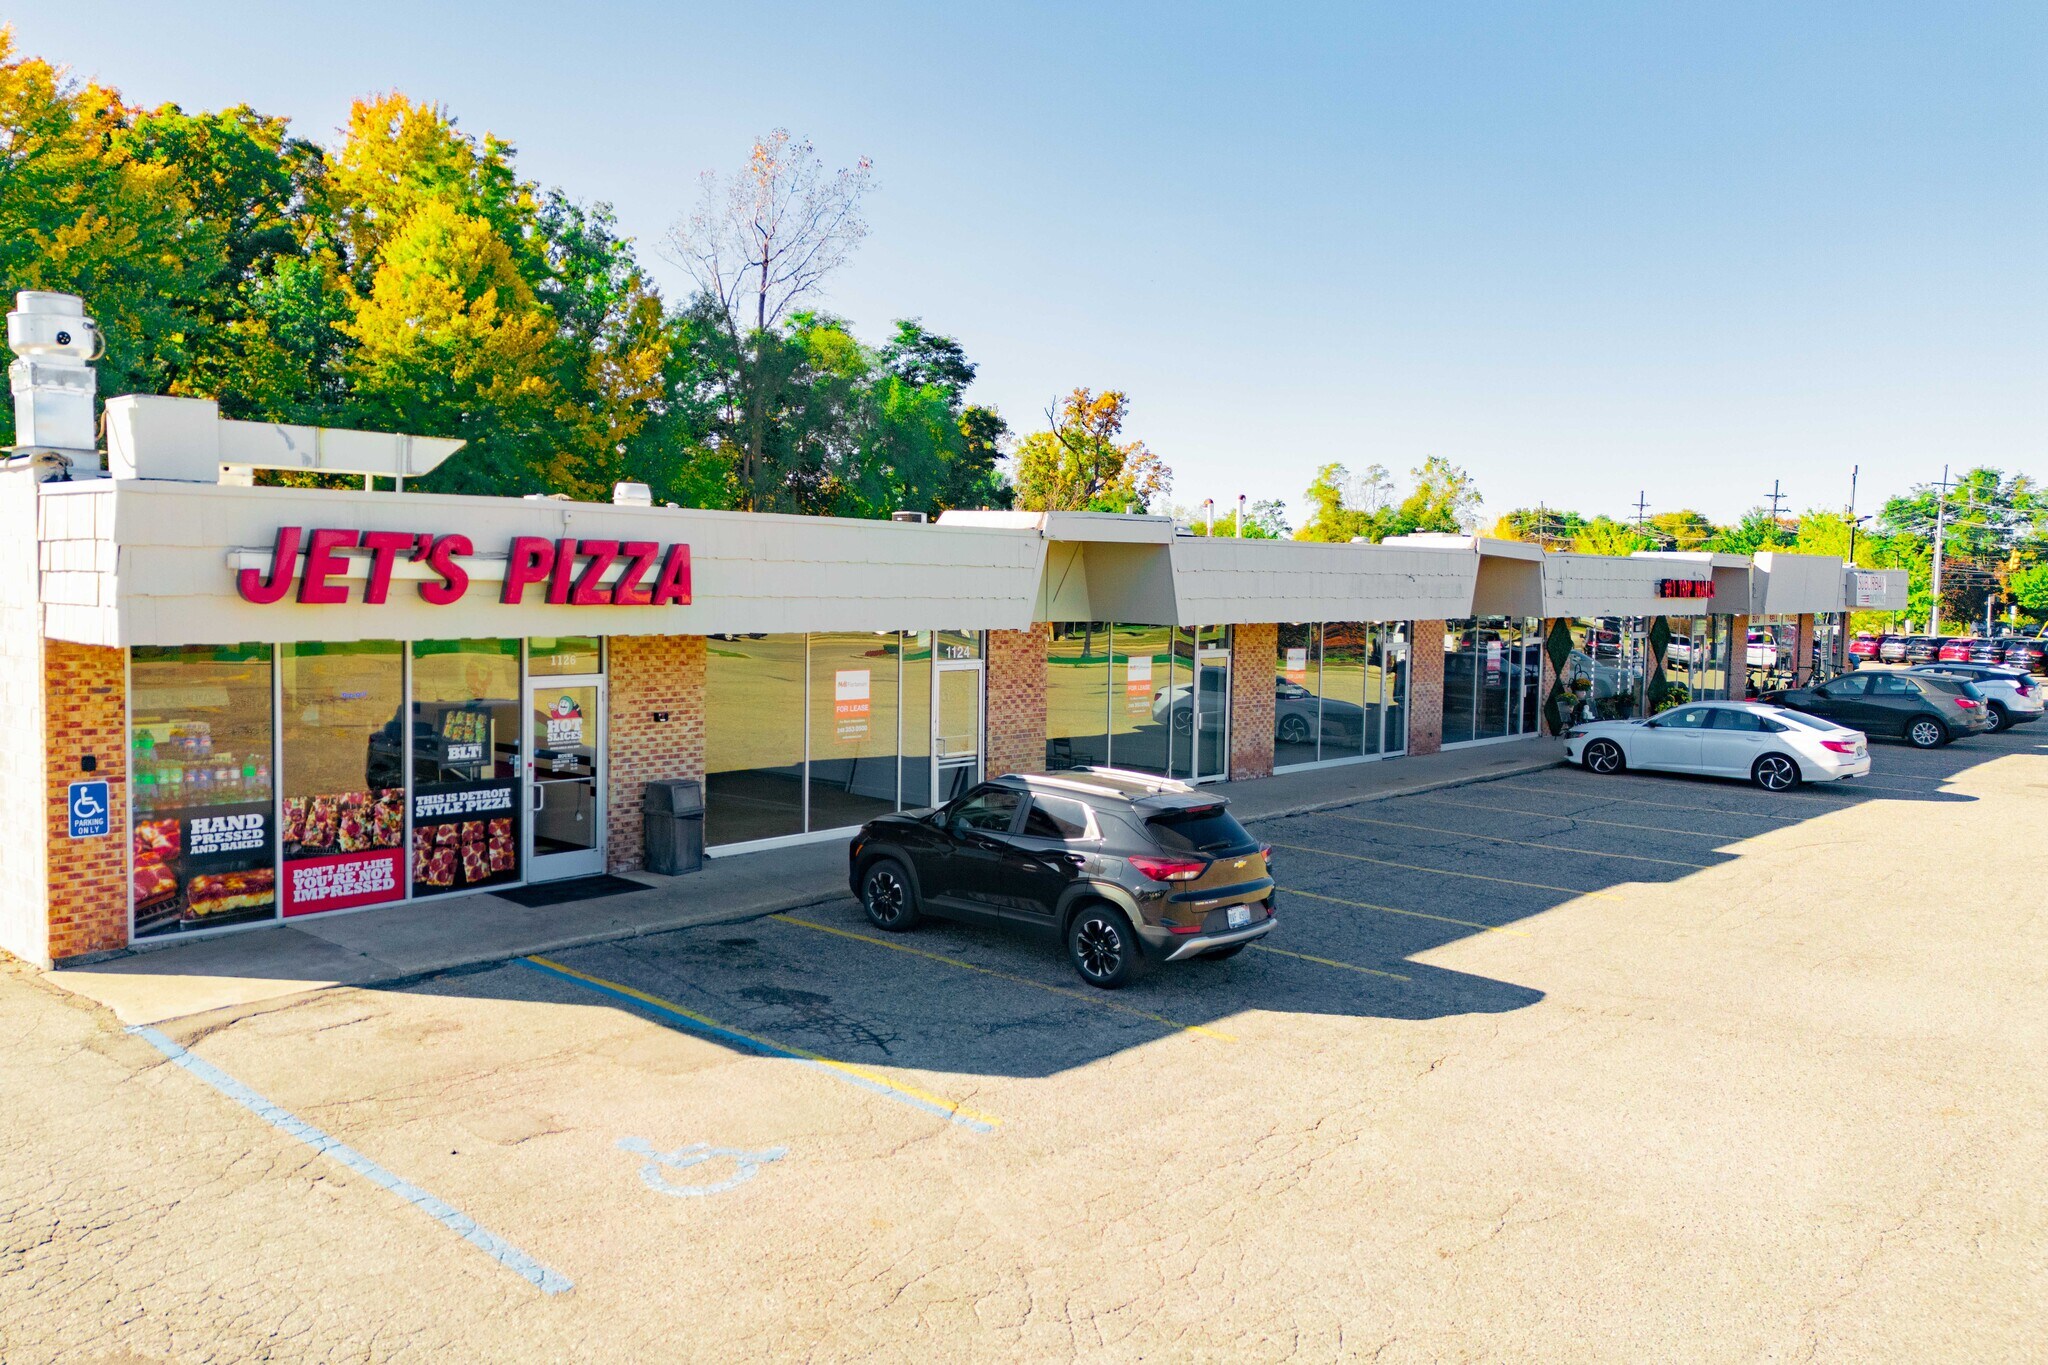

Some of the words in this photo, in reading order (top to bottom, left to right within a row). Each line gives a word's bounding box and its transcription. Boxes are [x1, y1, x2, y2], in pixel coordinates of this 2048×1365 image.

[237, 526, 474, 606] JET'S
[500, 536, 692, 606] PIZZA
[1752, 615, 1760, 623] BUY
[1769, 614, 1778, 623] SELL
[1785, 614, 1797, 622] TRADE
[946, 645, 970, 659] 1124
[551, 655, 576, 666] 1126
[836, 705, 849, 713] FOR
[850, 704, 869, 712] LEASE
[547, 718, 583, 735] HOT
[547, 731, 583, 742] SLICES
[415, 793, 445, 806] THIS
[446, 792, 458, 803] IS
[459, 788, 511, 802] DETROIT
[415, 801, 463, 818] STYLE
[465, 797, 512, 812] PIZZA
[74, 817, 104, 827] PARKING
[78, 825, 100, 835] ONLY
[190, 813, 264, 835] HAND
[190, 828, 264, 846] PRESSED
[190, 843, 219, 855] AND
[220, 839, 264, 852] BAKED
[293, 865, 335, 879] DON'T
[336, 861, 362, 873] ACT
[363, 858, 393, 870] LIKE
[293, 871, 356, 891] YOU'RE
[358, 867, 393, 881] NOT
[293, 878, 395, 903] IMPRESSED
